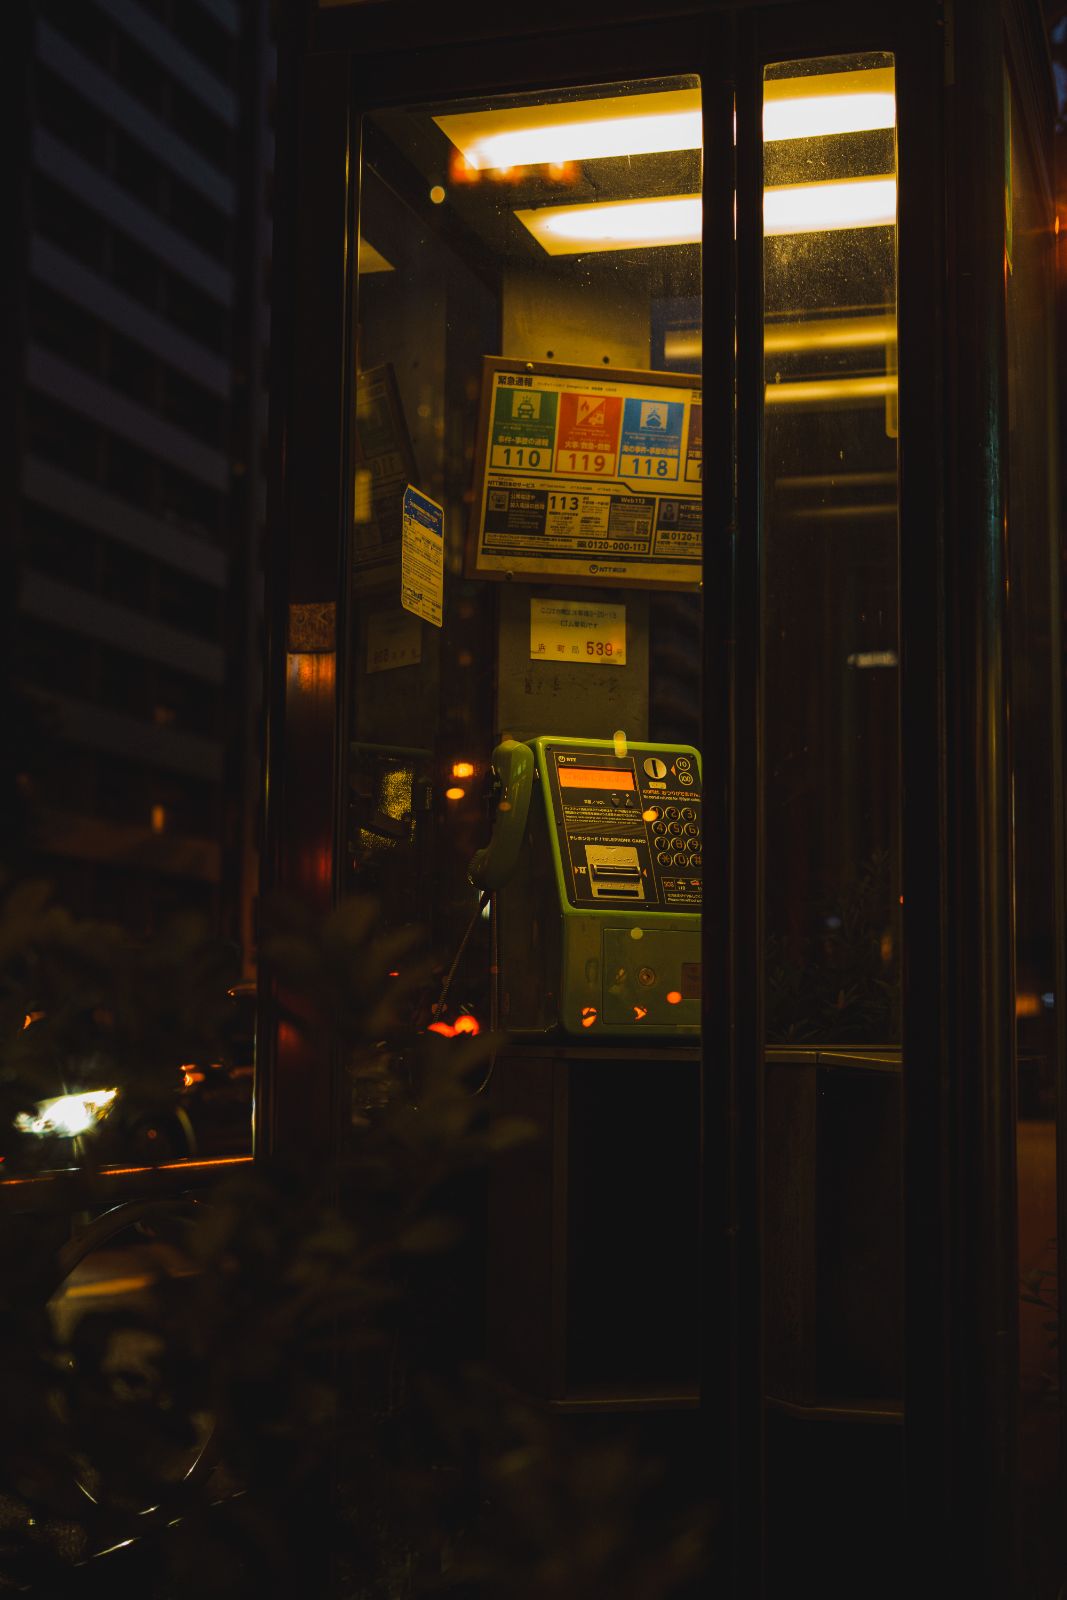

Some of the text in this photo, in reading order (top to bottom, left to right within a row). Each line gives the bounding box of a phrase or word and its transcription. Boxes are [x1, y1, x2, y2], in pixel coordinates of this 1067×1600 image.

[497, 375, 533, 387] 緊急通報
[503, 448, 540, 467] 110
[568, 453, 605, 472] 119
[633, 458, 668, 477] 118
[550, 495, 579, 511] 113
[587, 540, 647, 551] 0120-000-113
[586, 641, 613, 657] 539
